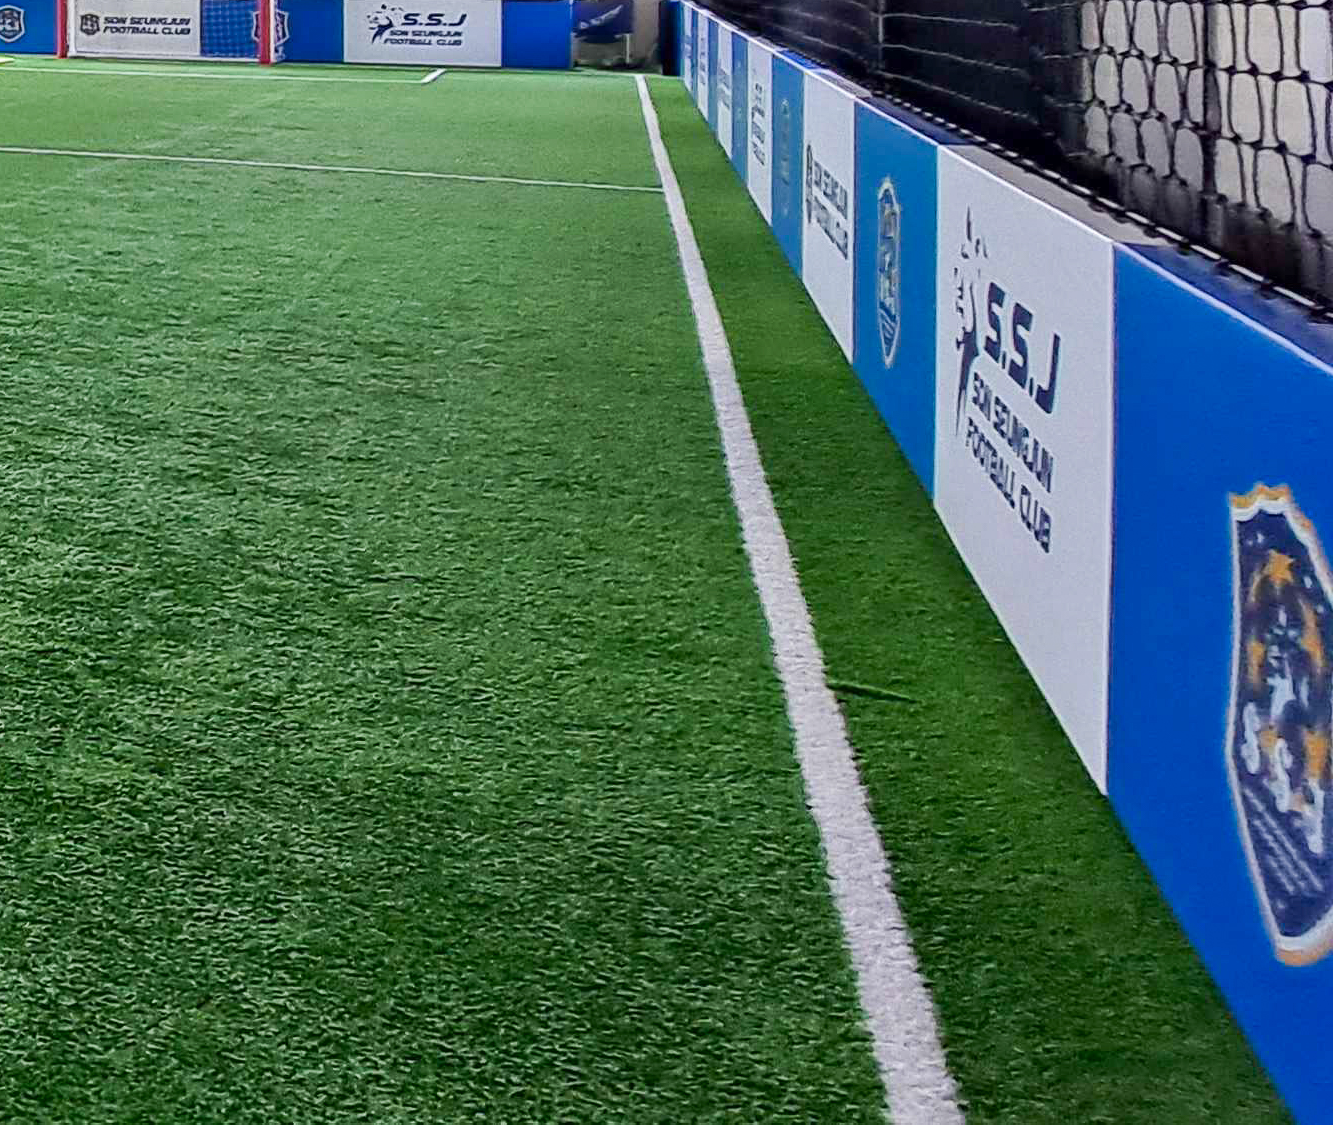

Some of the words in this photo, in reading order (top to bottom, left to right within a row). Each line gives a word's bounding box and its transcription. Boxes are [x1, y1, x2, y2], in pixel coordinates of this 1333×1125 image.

[103, 26, 159, 35] FOOTBALL
[161, 27, 191, 35] CLUB
[401, 13, 467, 26] S.S.J
[984, 281, 1062, 415] S.S.J
[1019, 483, 1052, 554] CLUB
